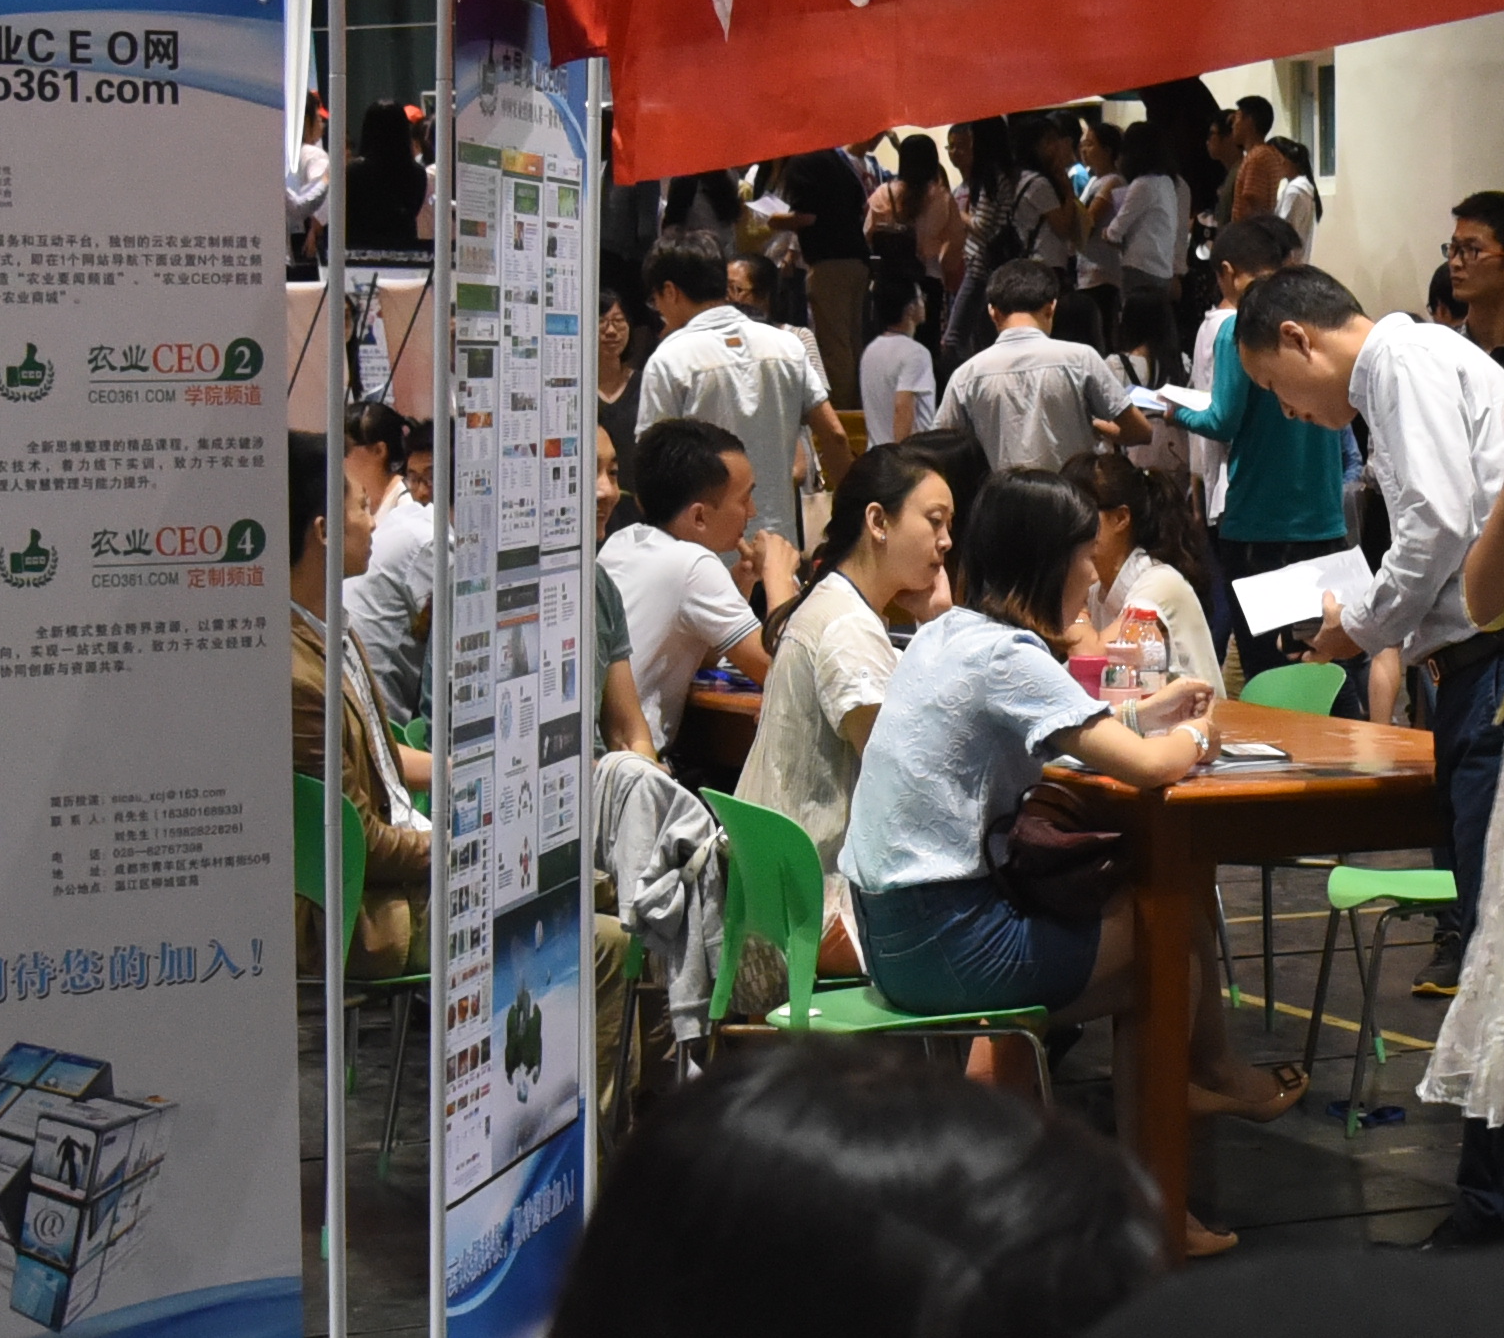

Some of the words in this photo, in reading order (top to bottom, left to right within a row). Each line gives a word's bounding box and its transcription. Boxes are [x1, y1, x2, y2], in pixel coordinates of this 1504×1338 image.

[234, 345, 252, 375] 2
[184, 384, 263, 406] 学院频道
[237, 526, 255, 556] 4
[187, 565, 265, 589] 定制频道
